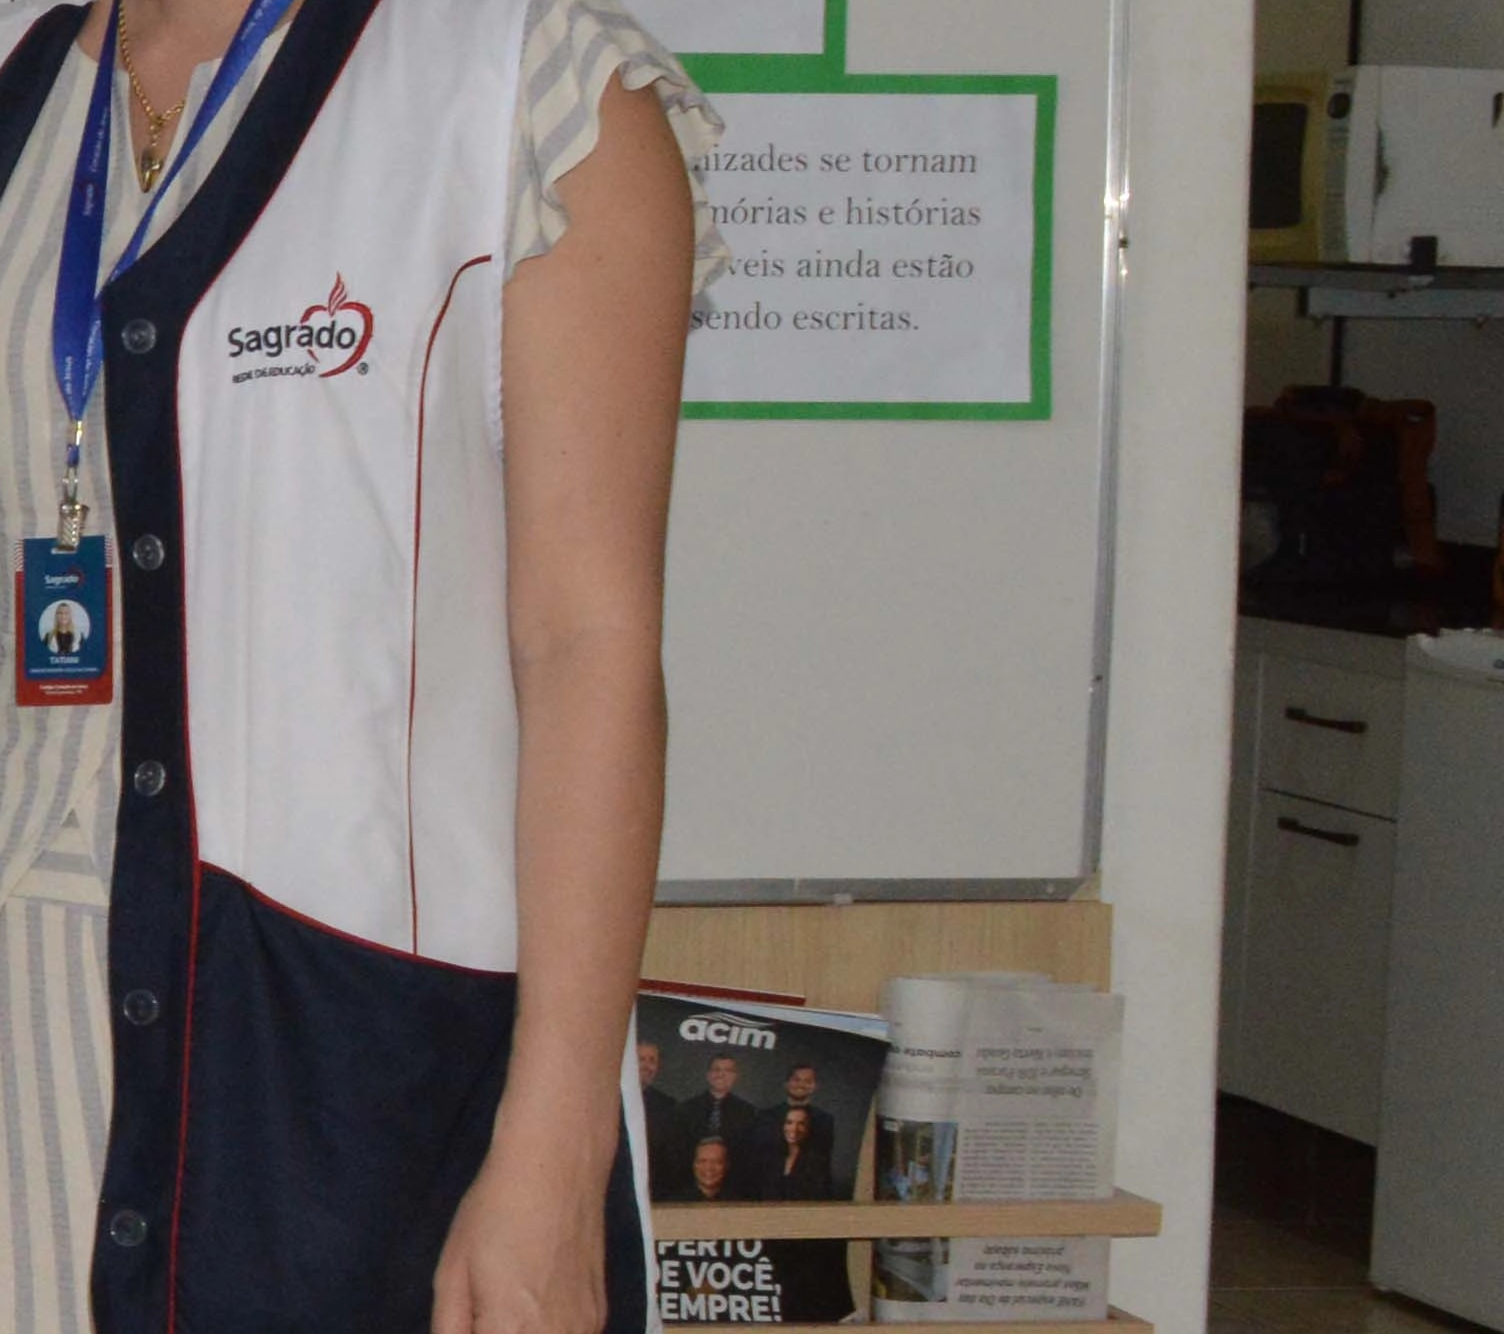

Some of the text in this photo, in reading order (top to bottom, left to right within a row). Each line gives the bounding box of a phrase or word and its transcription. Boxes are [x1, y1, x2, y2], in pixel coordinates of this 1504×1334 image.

[820, 153, 851, 172] se
[862, 147, 977, 174] tornam
[818, 205, 835, 225] e
[845, 197, 982, 226] histórias
[797, 251, 880, 278] ainda
[892, 255, 974, 280] estão
[691, 302, 920, 332] sendo escritas.
[228, 320, 356, 357] Sagrado
[679, 1015, 777, 1050] acim
[685, 1256, 781, 1295] VOCÊ,
[658, 1292, 783, 1323] EMPRE!
